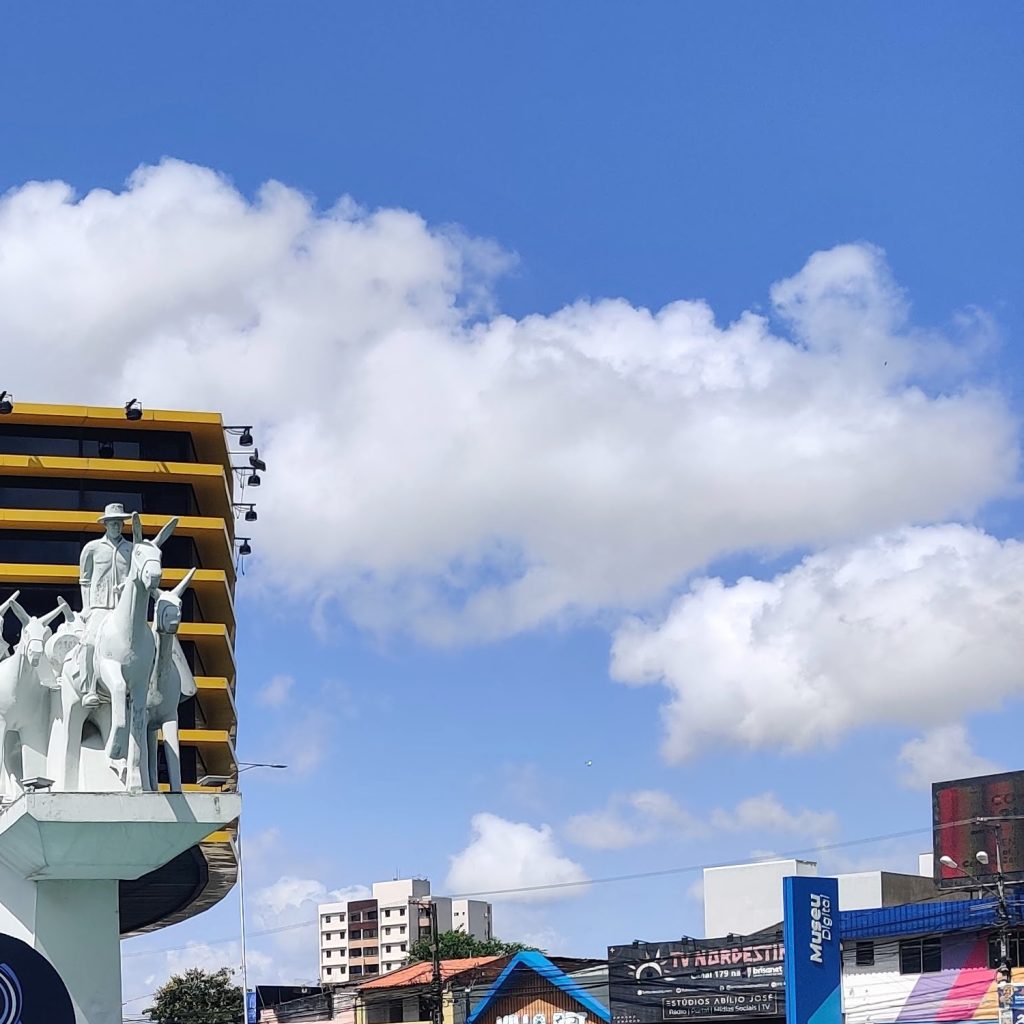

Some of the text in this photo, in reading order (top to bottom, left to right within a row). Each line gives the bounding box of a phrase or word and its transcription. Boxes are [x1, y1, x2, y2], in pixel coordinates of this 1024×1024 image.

[820, 894, 832, 941] Digital
[810, 893, 823, 963] Museu
[670, 951, 690, 968] TV
[714, 969, 729, 978] 179
[753, 965, 783, 975] brisanet
[714, 995, 745, 1005] ABÍLIO
